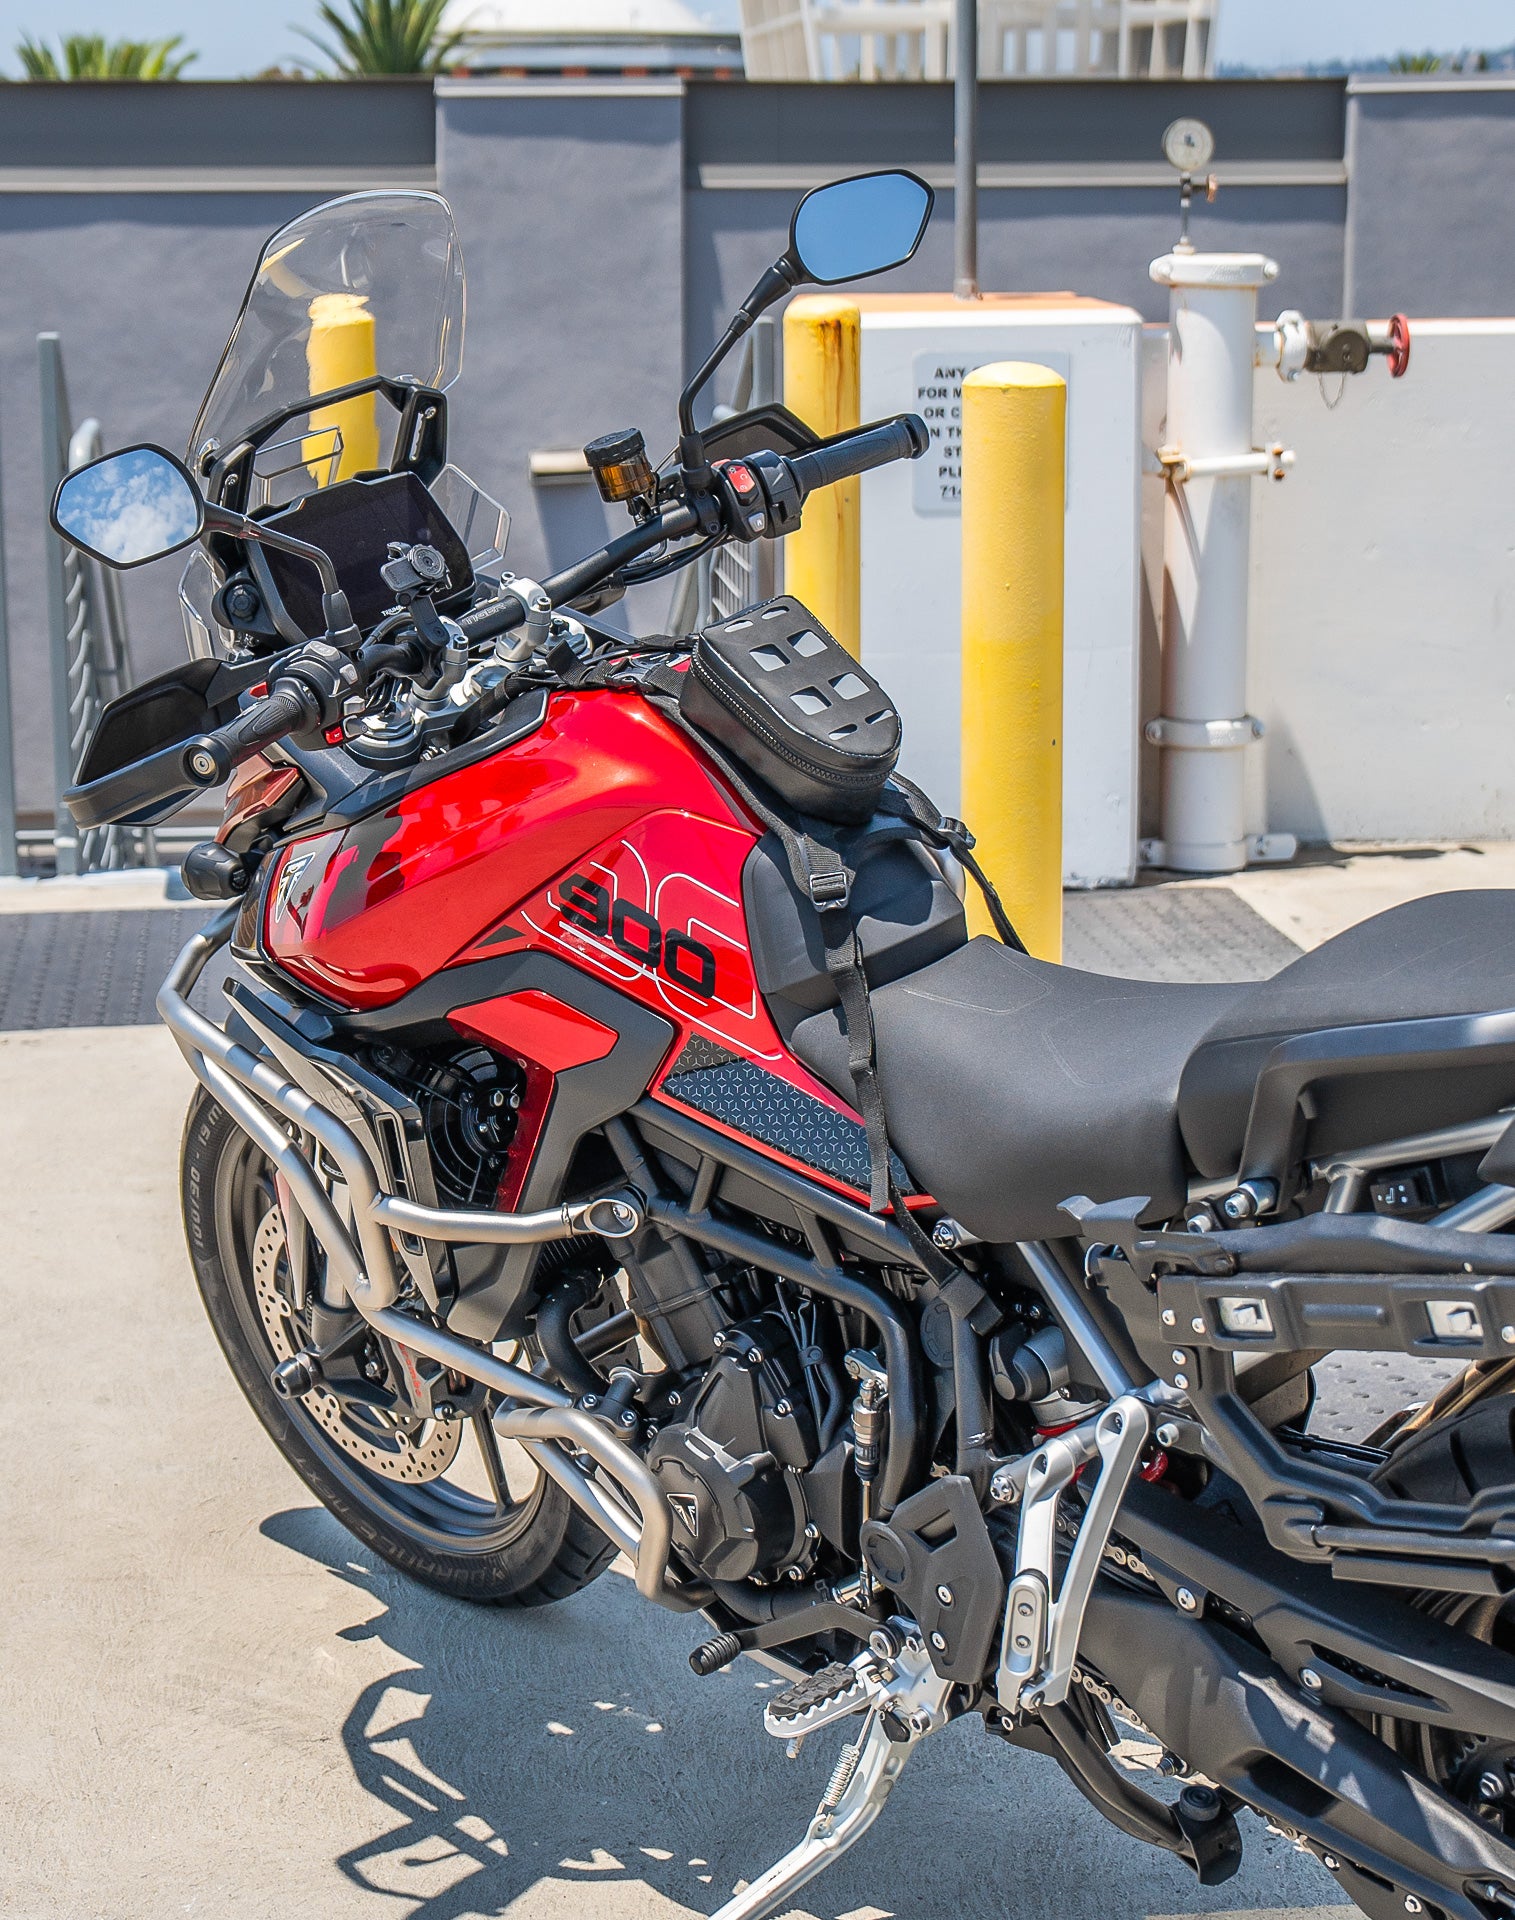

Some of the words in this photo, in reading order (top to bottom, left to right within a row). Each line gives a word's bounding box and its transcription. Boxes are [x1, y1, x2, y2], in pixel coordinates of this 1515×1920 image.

[934, 367, 965, 379] ANY
[918, 386, 947, 399] FOR
[924, 406, 945, 419] OR
[930, 427, 940, 438] N
[558, 873, 716, 999] 900
